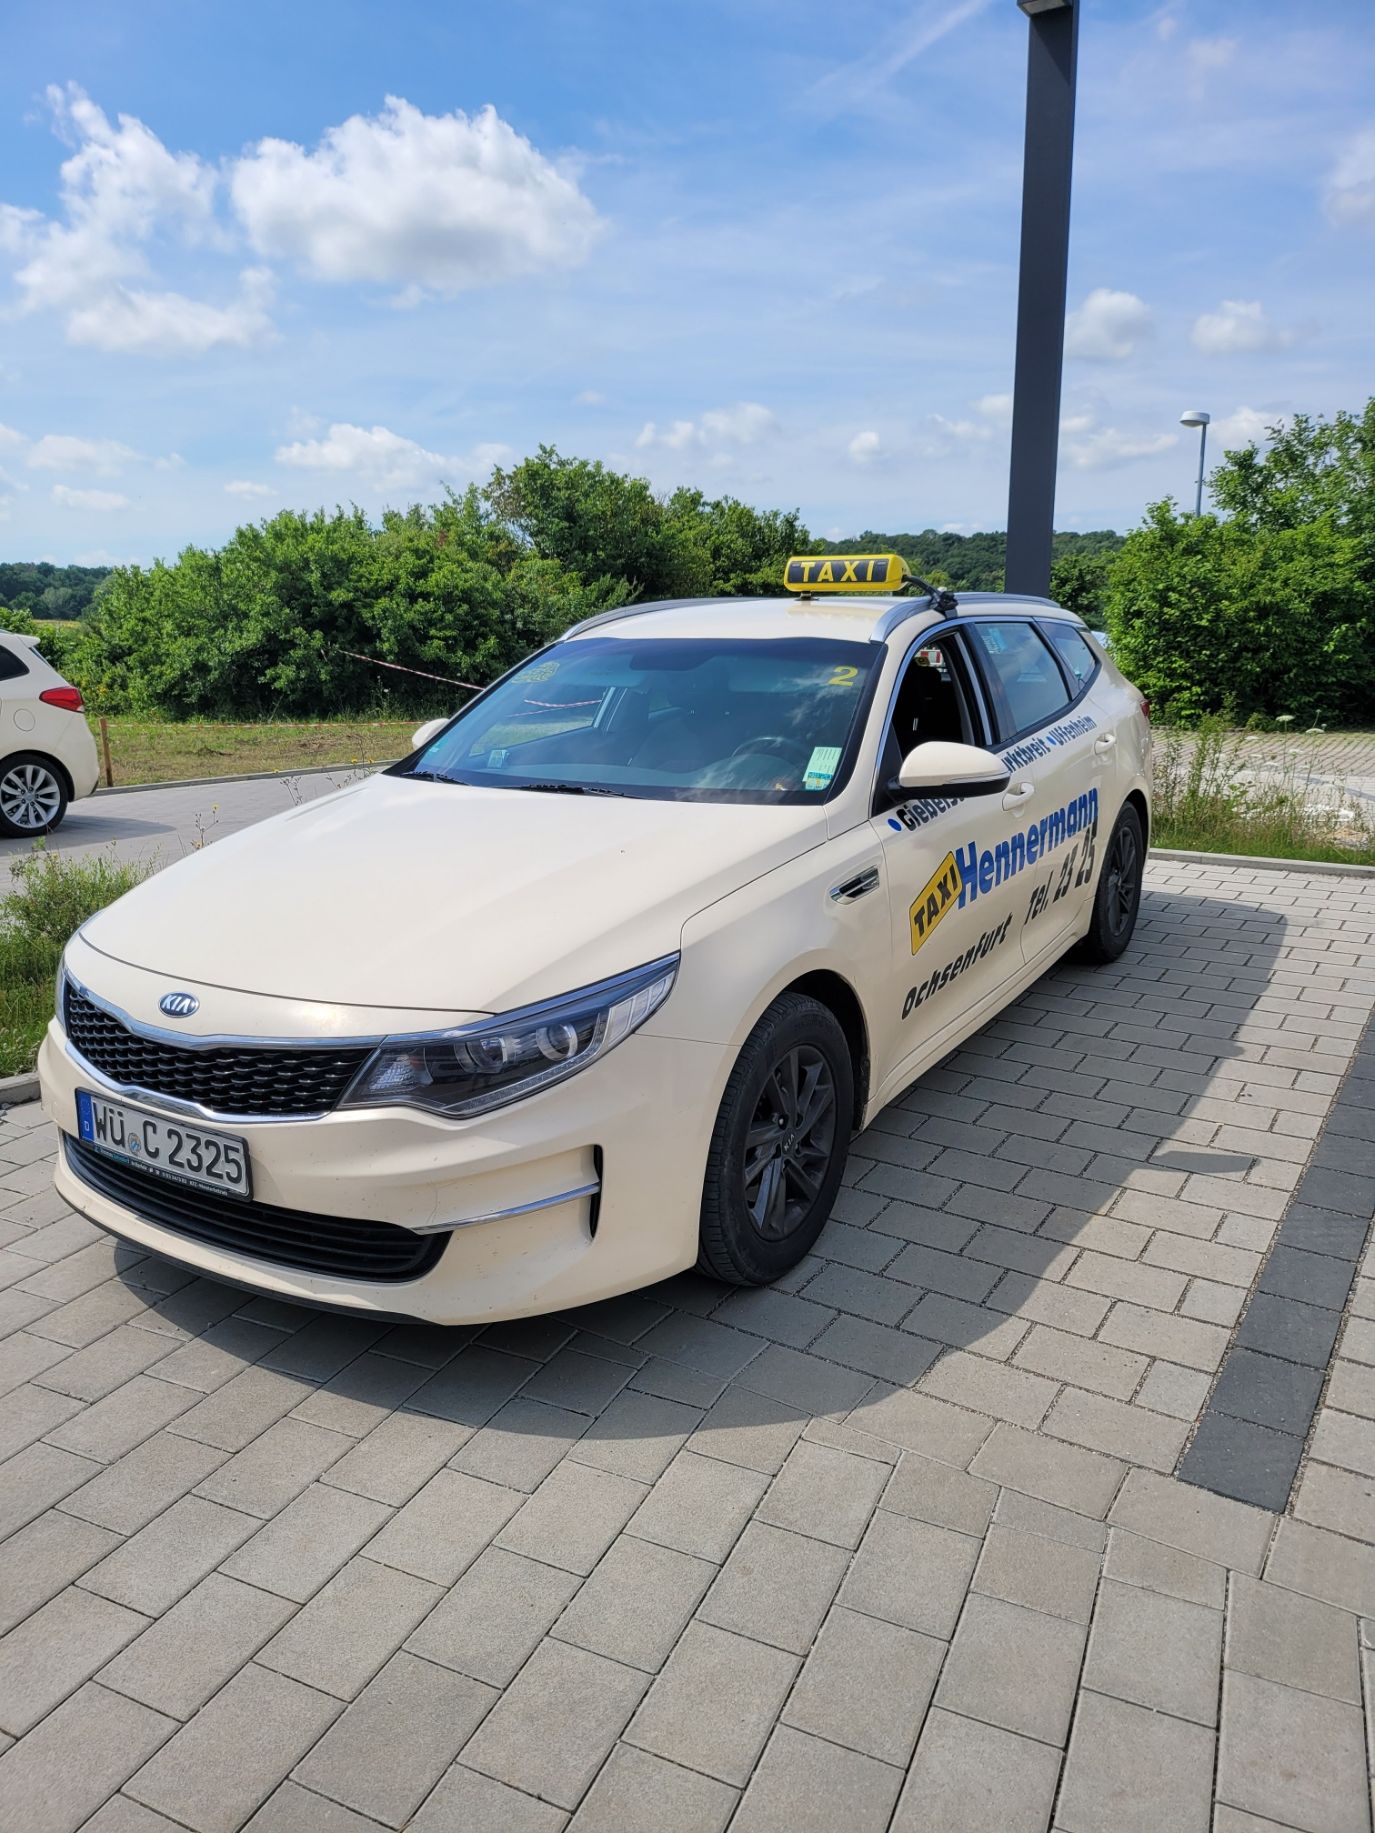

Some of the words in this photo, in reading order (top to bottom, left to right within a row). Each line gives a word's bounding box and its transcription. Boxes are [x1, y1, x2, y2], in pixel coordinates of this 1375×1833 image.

[800, 560, 875, 583] TAXI
[828, 665, 859, 687] 2
[896, 797, 965, 832] Giebe
[1049, 715, 1098, 746] Uffenheim
[913, 864, 958, 938] TAXI
[955, 787, 1099, 910] Hennermann
[162, 994, 192, 1014] KIA
[901, 911, 1013, 1021] Ochsenfurt
[93, 1101, 126, 1148] WÜ
[143, 1120, 160, 1159] C
[167, 1128, 243, 1184] 2325
